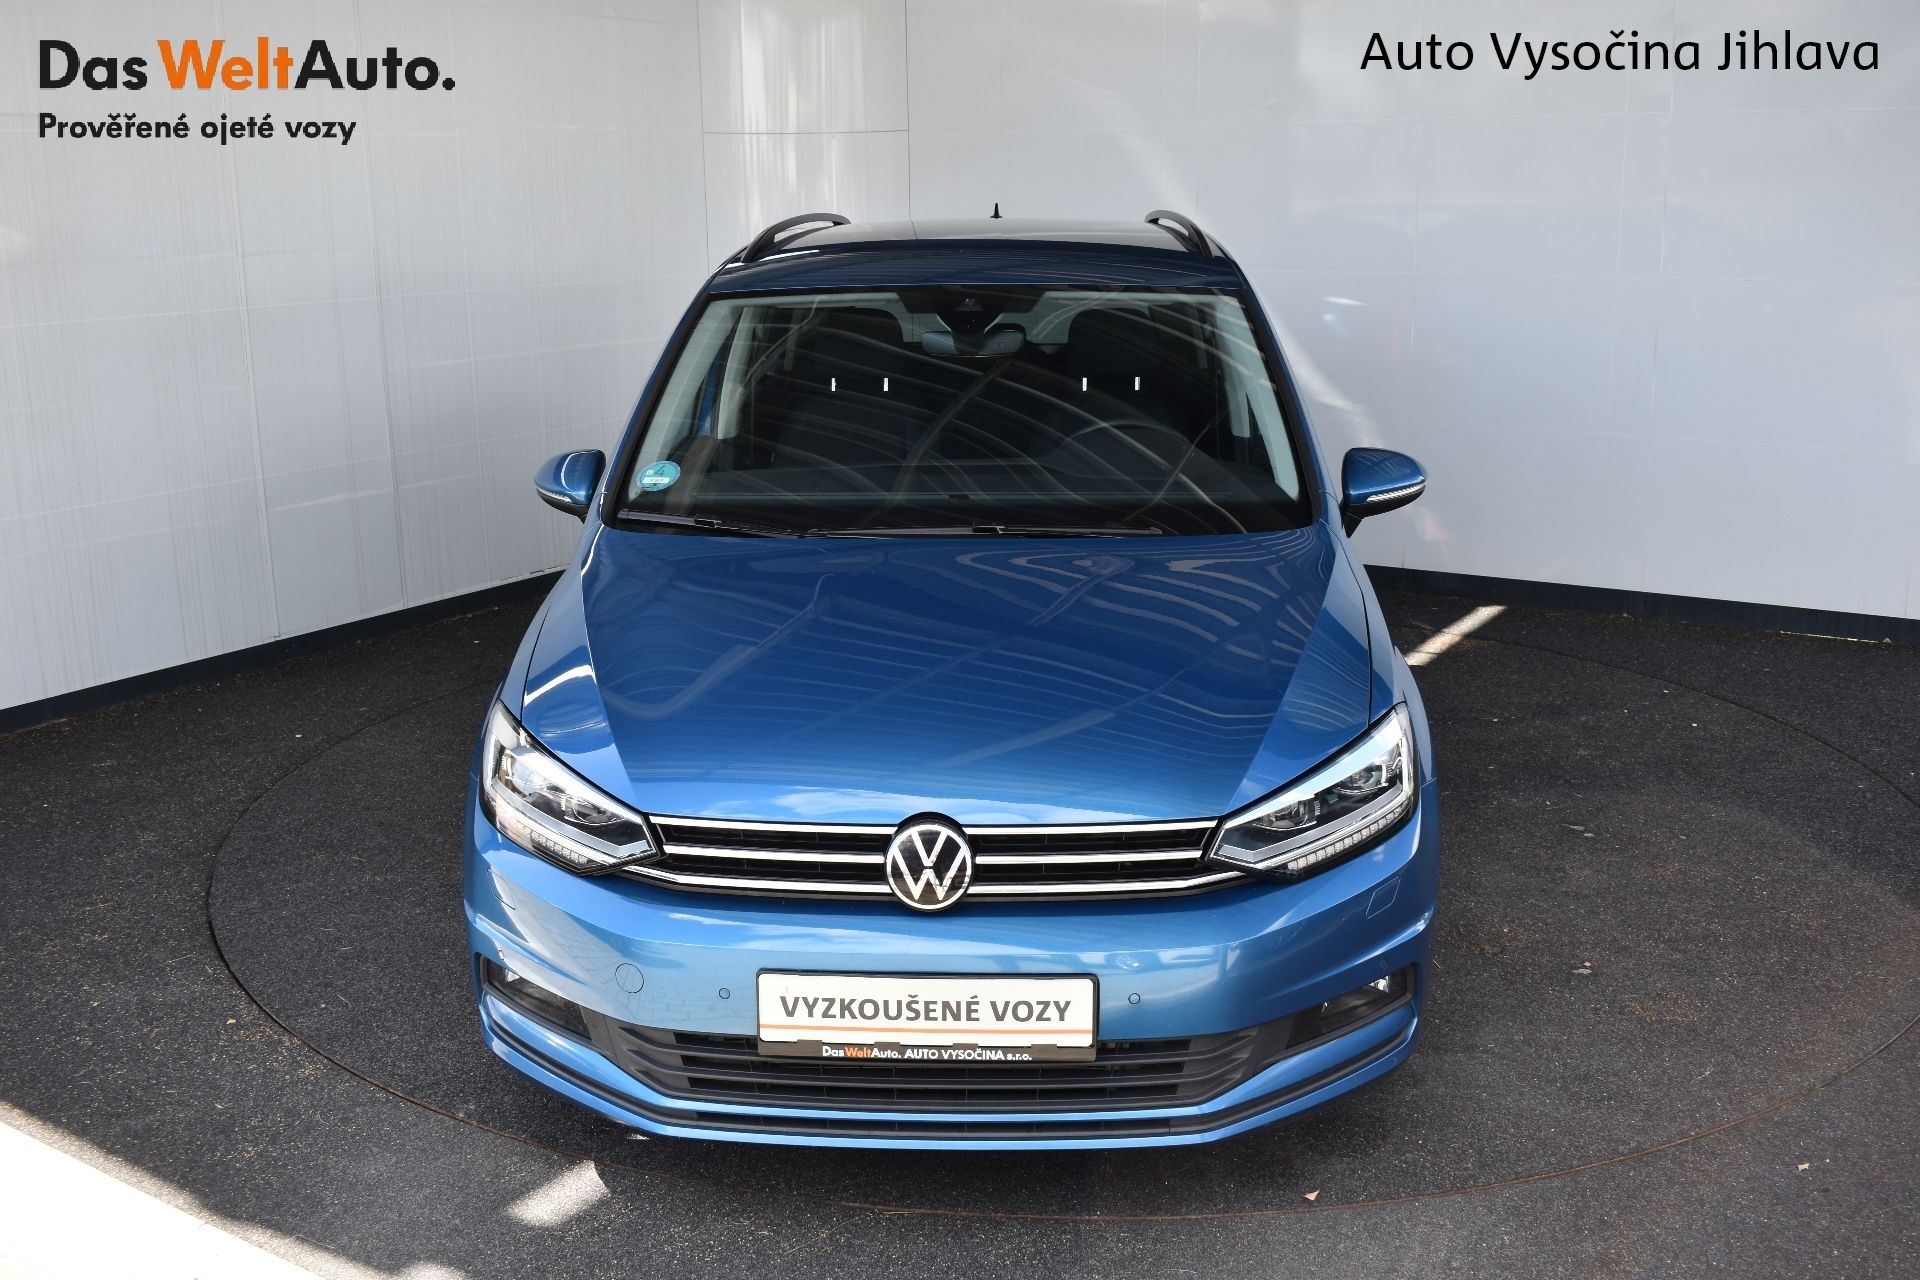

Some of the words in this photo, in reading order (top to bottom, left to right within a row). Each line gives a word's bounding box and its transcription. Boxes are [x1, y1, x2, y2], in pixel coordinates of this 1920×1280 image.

[891, 828, 967, 902] VW
[780, 994, 980, 1021] VYZKOUŠENÉ
[989, 1000, 1071, 1022] VOZY
[904, 1048, 939, 1060] AUTO
[940, 1047, 1005, 1060] VYSOČINA
